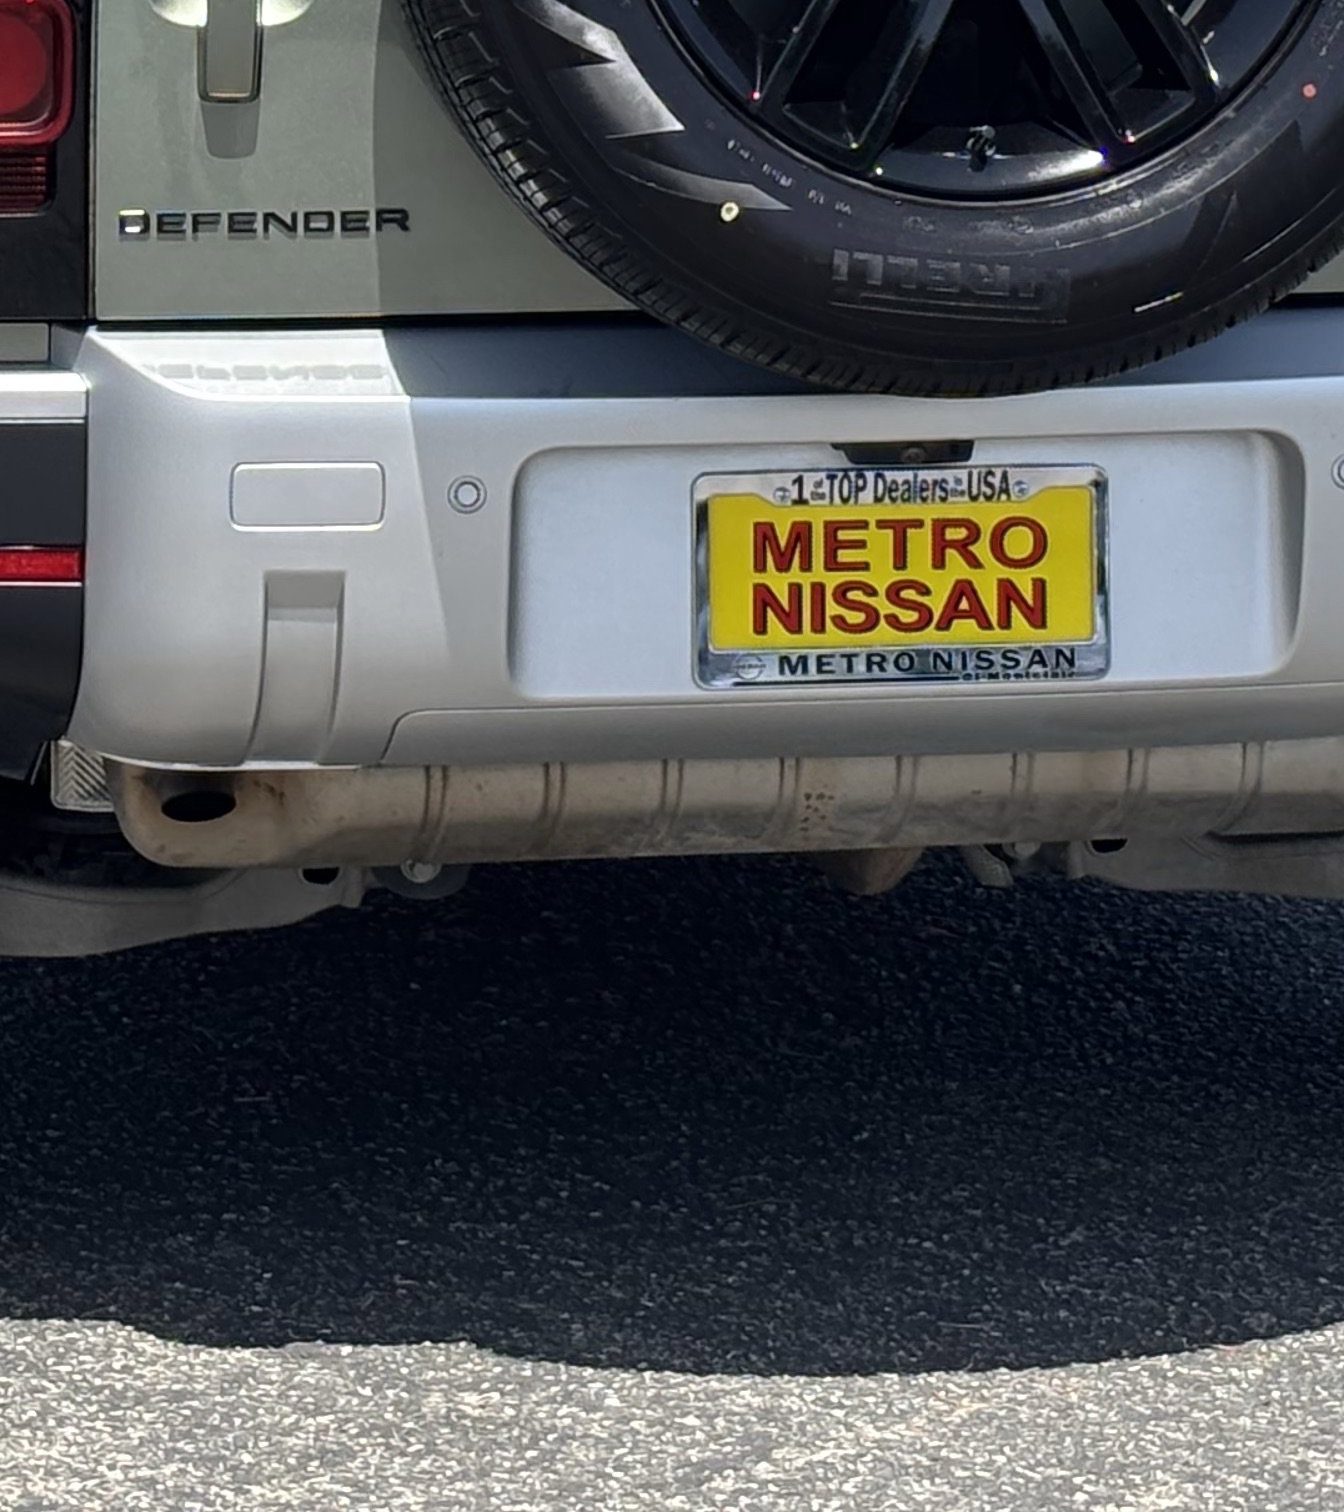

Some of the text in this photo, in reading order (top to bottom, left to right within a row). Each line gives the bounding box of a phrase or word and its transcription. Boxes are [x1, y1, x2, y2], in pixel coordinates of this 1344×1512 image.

[118, 208, 411, 234] DEFENDER
[791, 475, 809, 505] 1
[826, 472, 867, 504] TOP
[874, 472, 949, 504] Dealers
[967, 470, 1012, 501] USA
[752, 516, 1048, 573] METRO
[751, 578, 1048, 635] NISSAN
[778, 648, 1077, 676] METRO NISSAN
